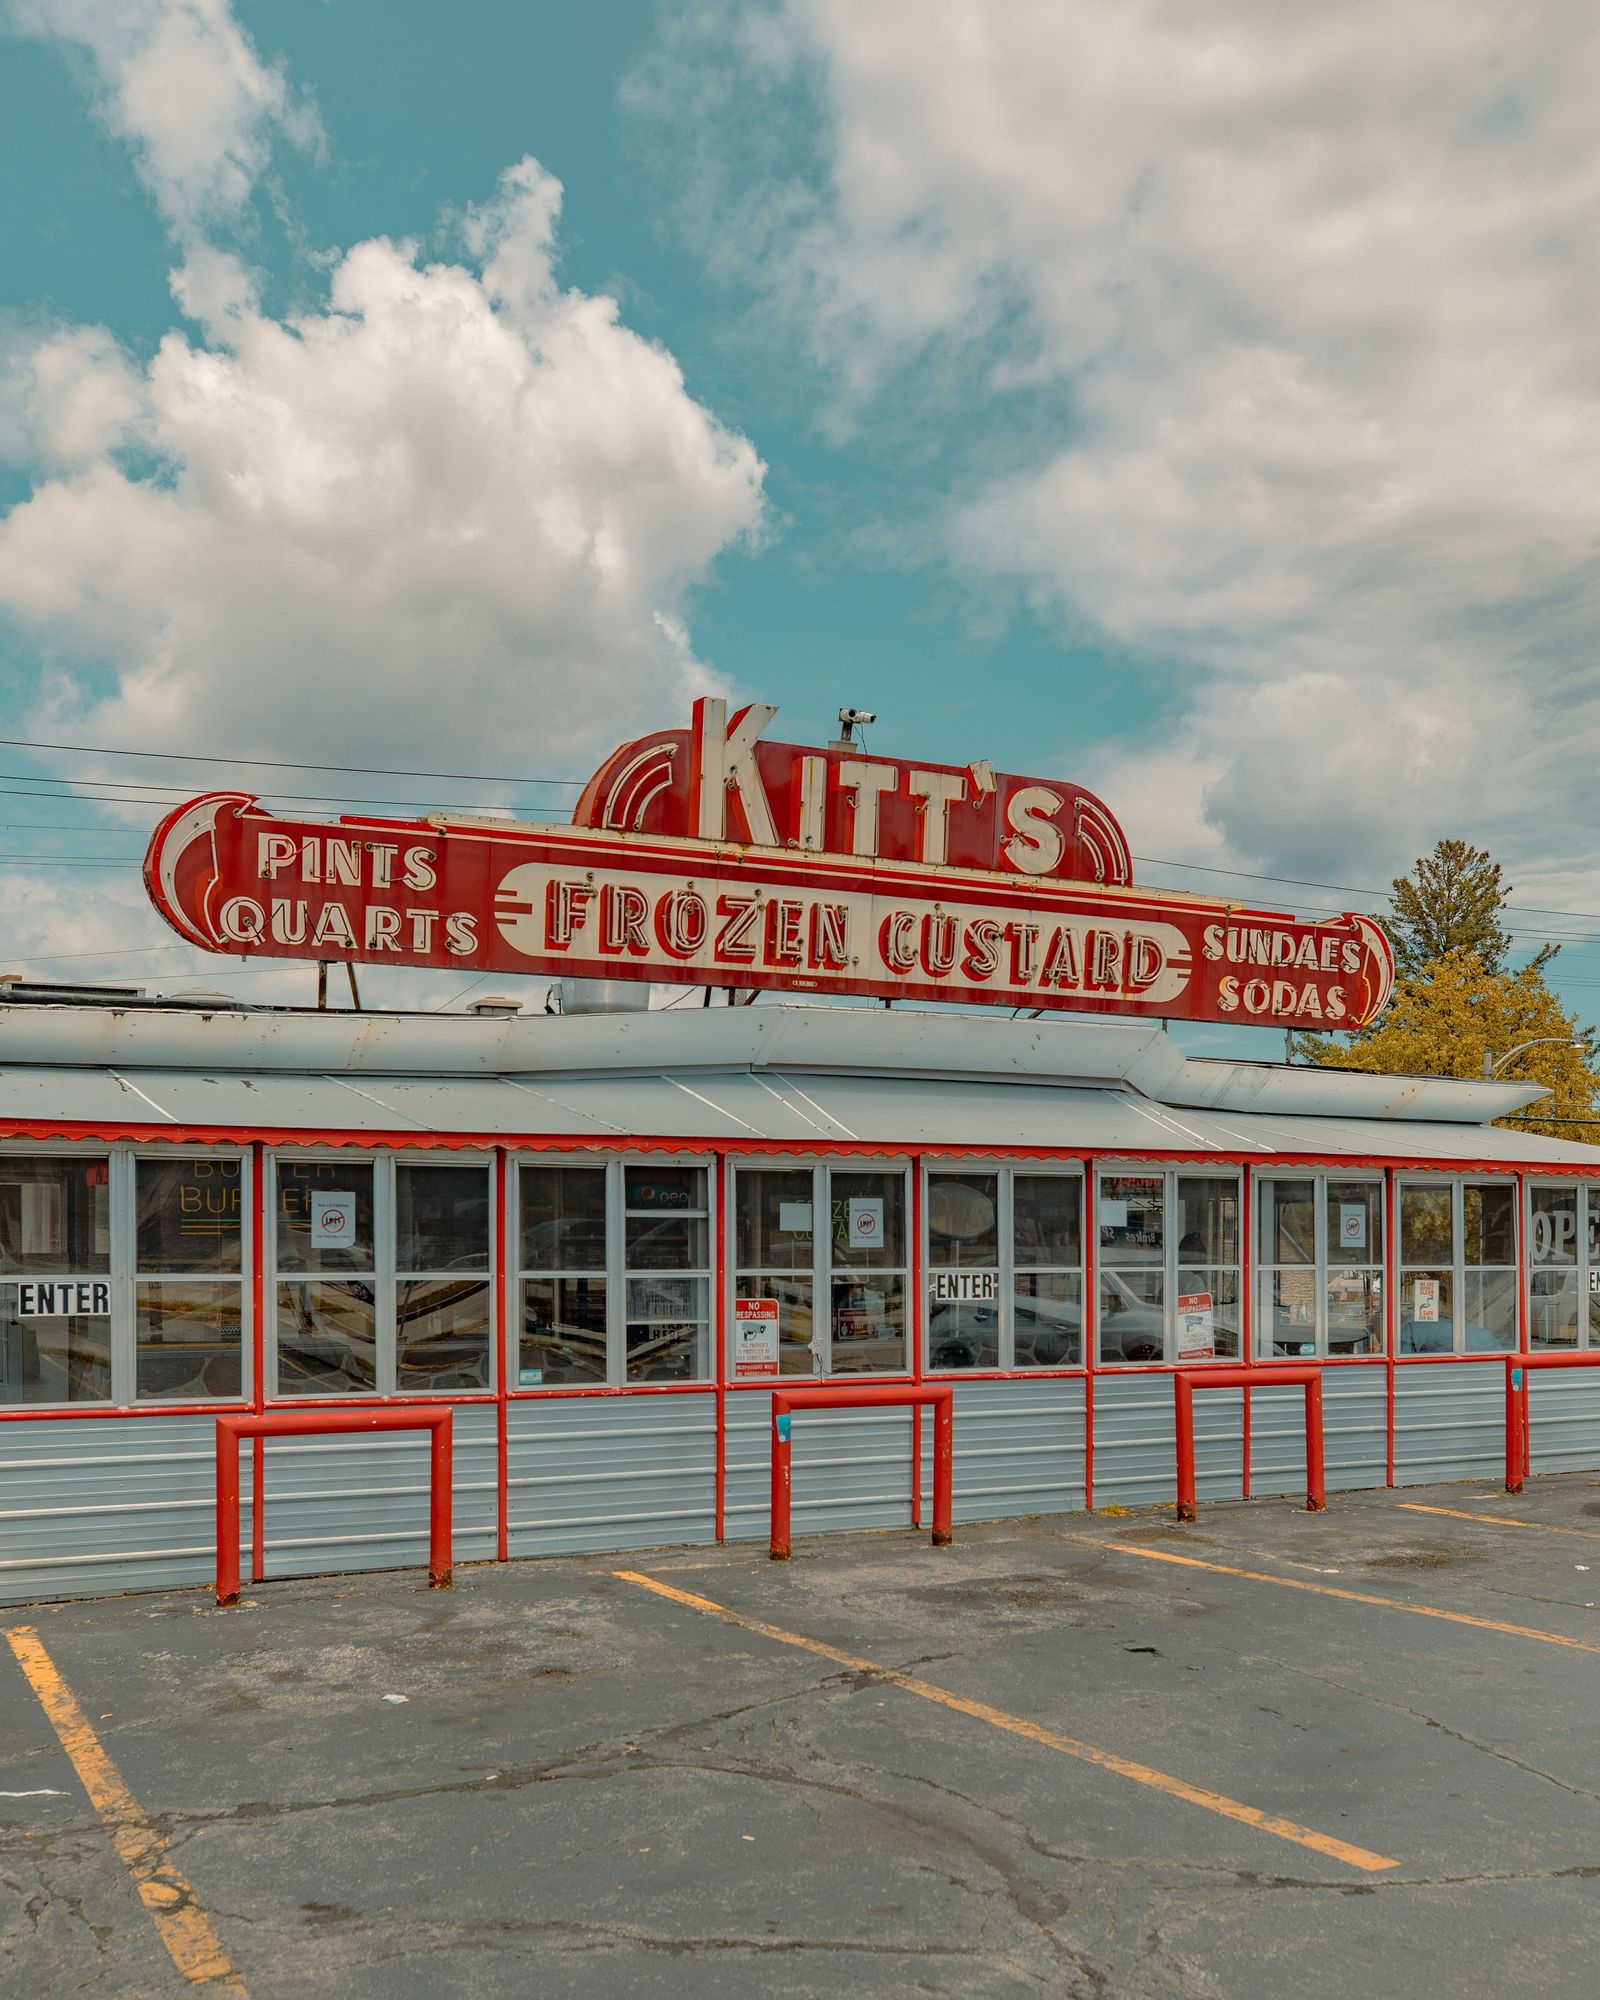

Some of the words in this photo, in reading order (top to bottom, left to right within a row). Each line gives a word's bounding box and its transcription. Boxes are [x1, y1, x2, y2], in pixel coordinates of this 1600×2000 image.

[692, 697, 1065, 874] KITT'S
[258, 833, 437, 891] PINTS
[220, 896, 478, 956] QUARTS
[545, 879, 850, 971] FROZEN
[1203, 924, 1361, 974] SUNDAES
[879, 910, 1167, 994] CUSTARD
[1218, 976, 1347, 1020] SODAS
[20, 1283, 109, 1314] ENTER
[748, 1302, 760, 1310] NO
[937, 1274, 992, 1298] ENTER
[736, 1311, 775, 1319] RESPASSING
